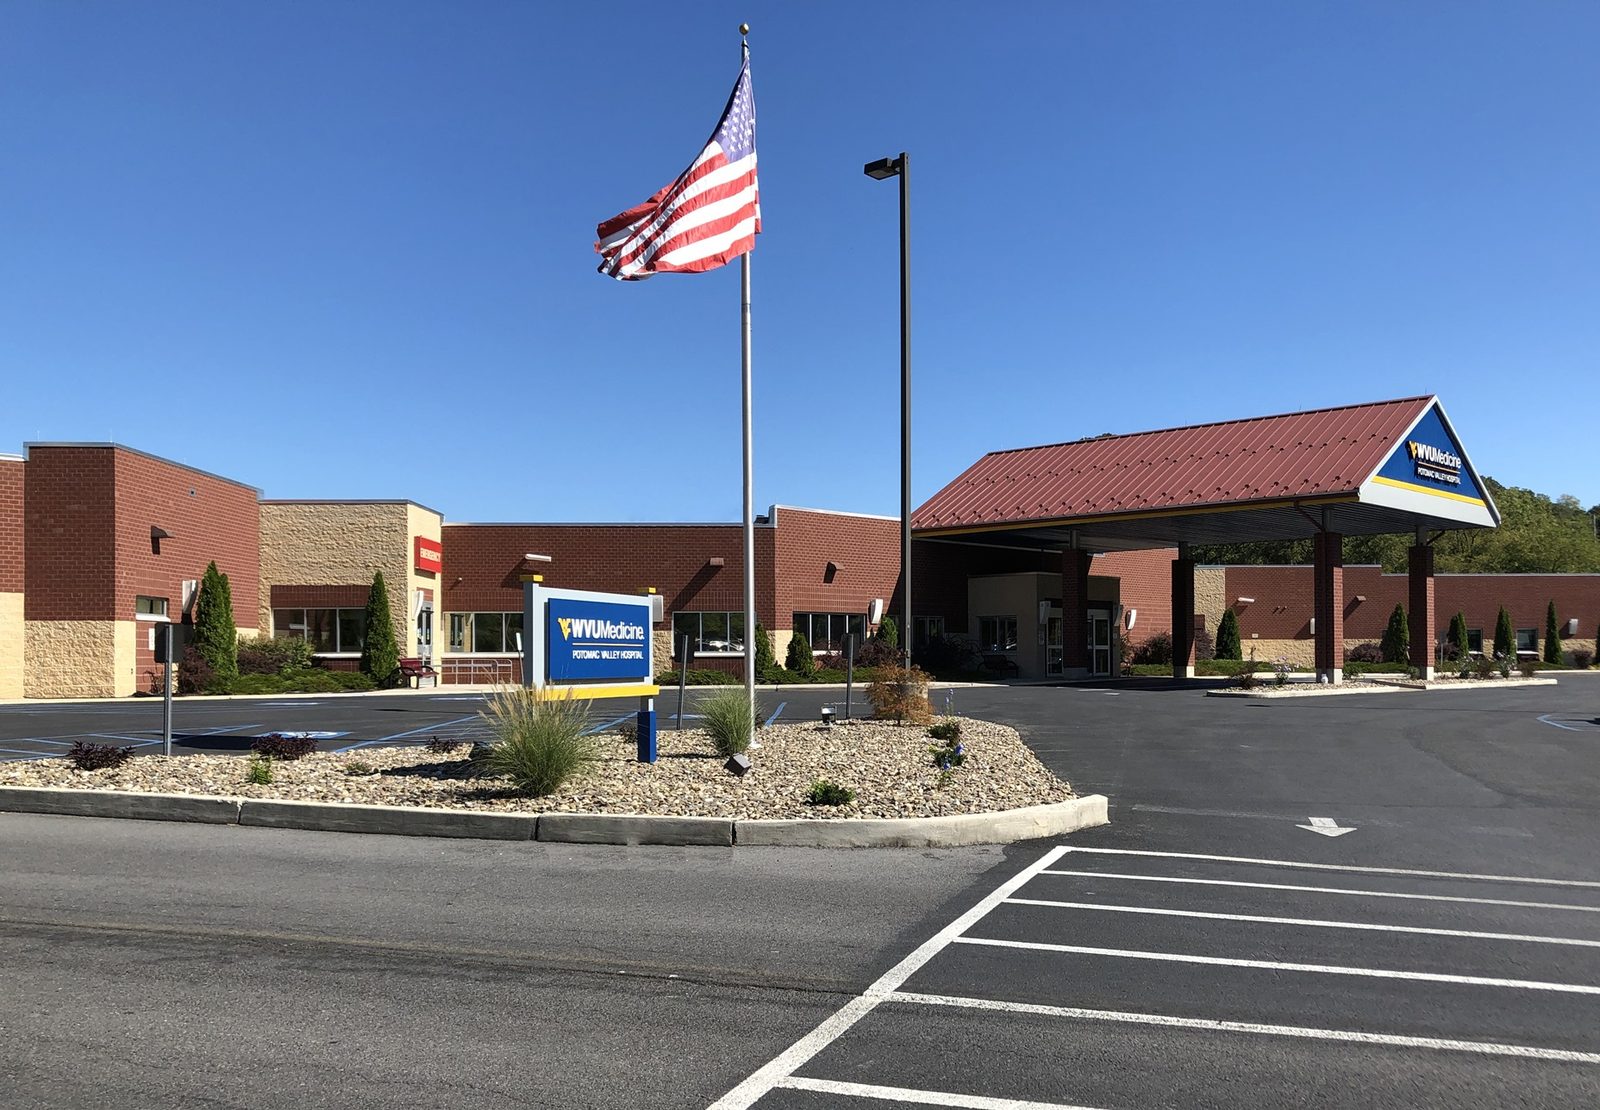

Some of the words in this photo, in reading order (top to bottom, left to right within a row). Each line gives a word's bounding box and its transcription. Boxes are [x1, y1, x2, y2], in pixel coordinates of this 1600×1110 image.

[572, 650, 600, 659] POTOMAC
[600, 650, 619, 659] VALLEY
[620, 651, 644, 659] HOSPITAL
